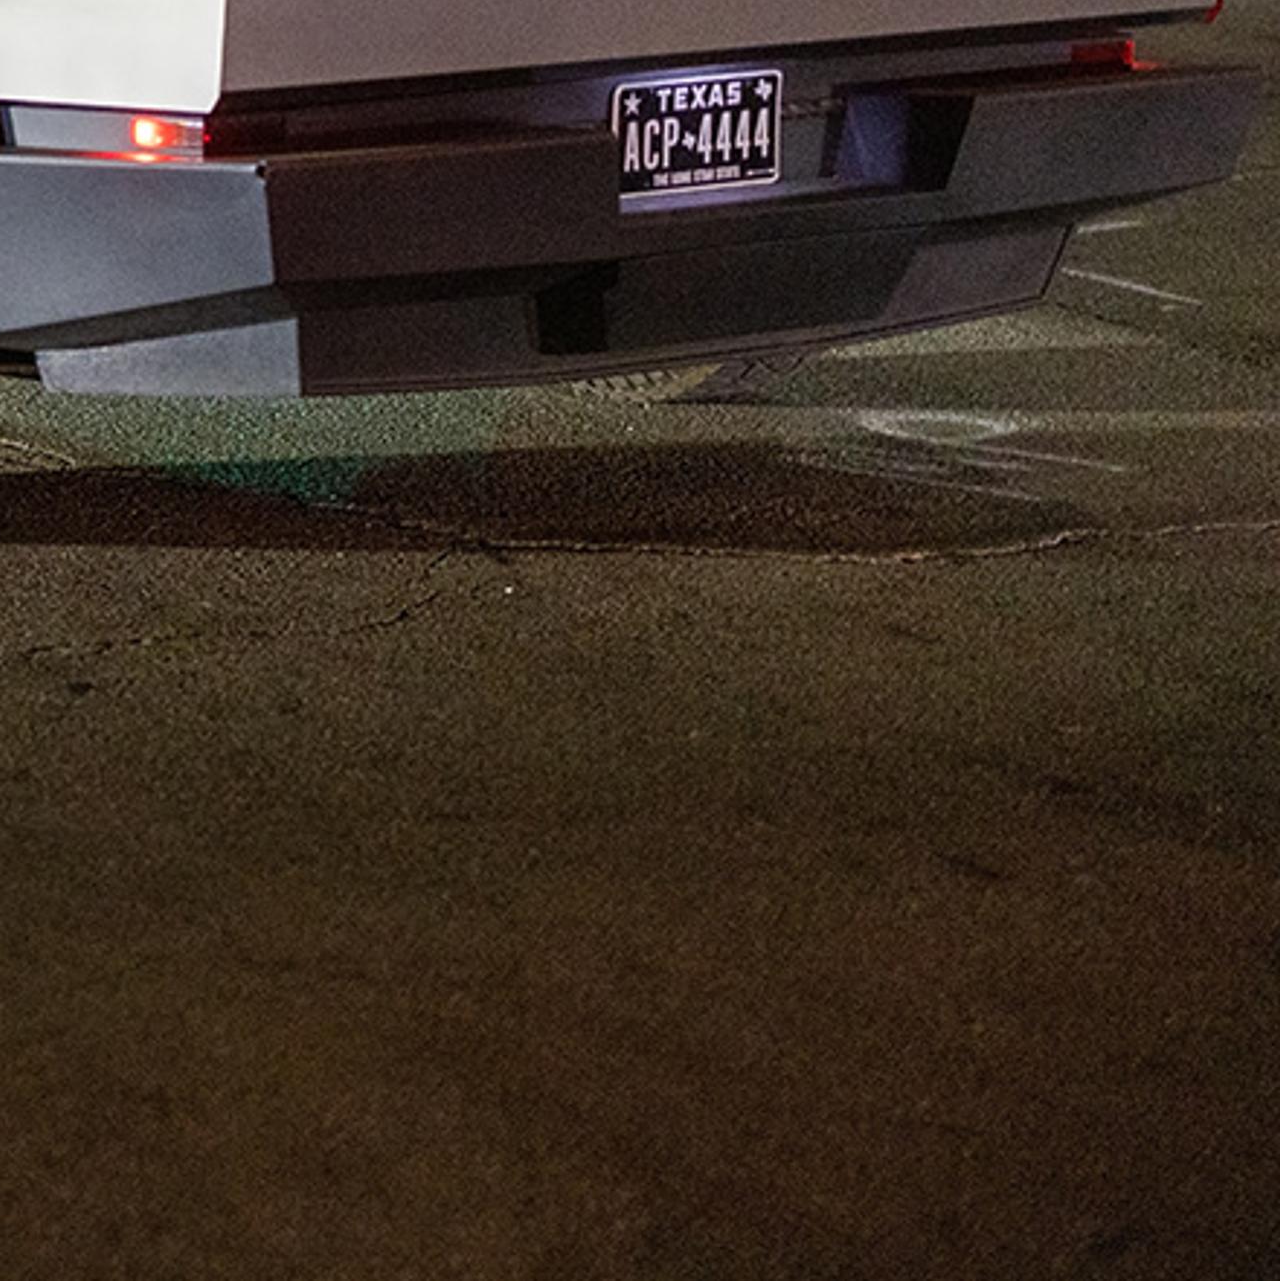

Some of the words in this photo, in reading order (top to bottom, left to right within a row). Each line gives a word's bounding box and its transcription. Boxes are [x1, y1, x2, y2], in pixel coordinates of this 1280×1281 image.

[657, 81, 742, 112] TEXAS
[623, 117, 681, 173] ACP
[697, 107, 770, 164] 4444
